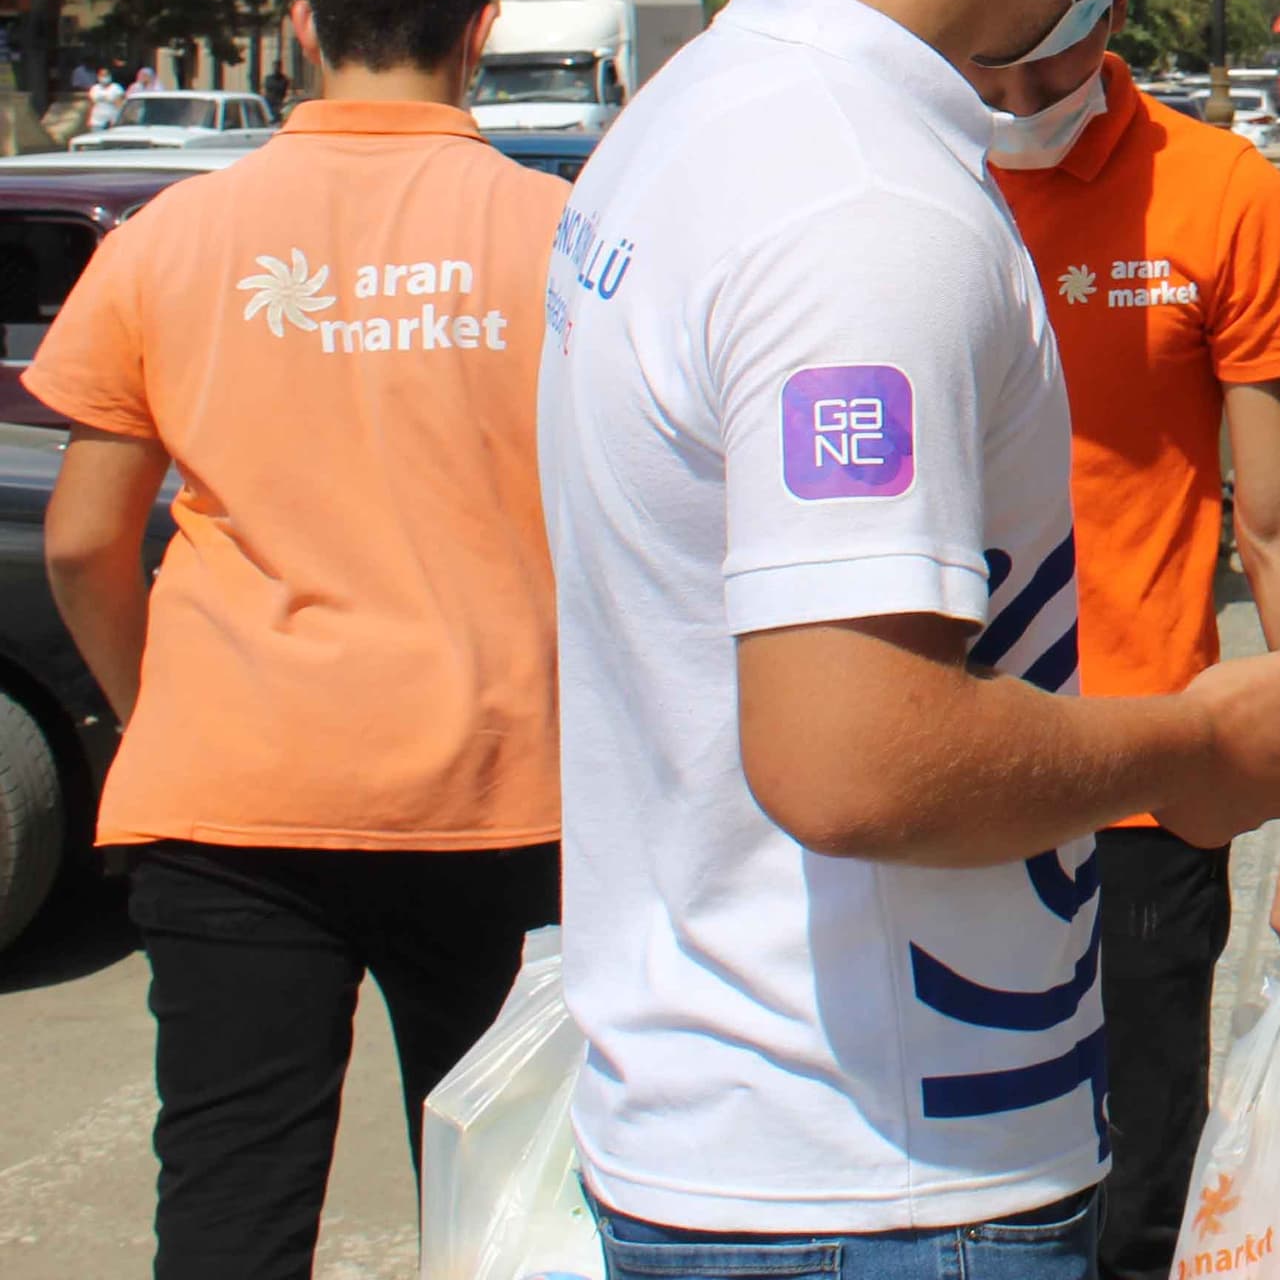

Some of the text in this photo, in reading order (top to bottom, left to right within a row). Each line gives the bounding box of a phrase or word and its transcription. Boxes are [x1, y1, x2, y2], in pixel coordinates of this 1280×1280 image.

[355, 259, 473, 298] aran
[1110, 258, 1171, 280] aran
[1108, 280, 1198, 308] market
[319, 303, 507, 353] market
[815, 431, 884, 468] NC
